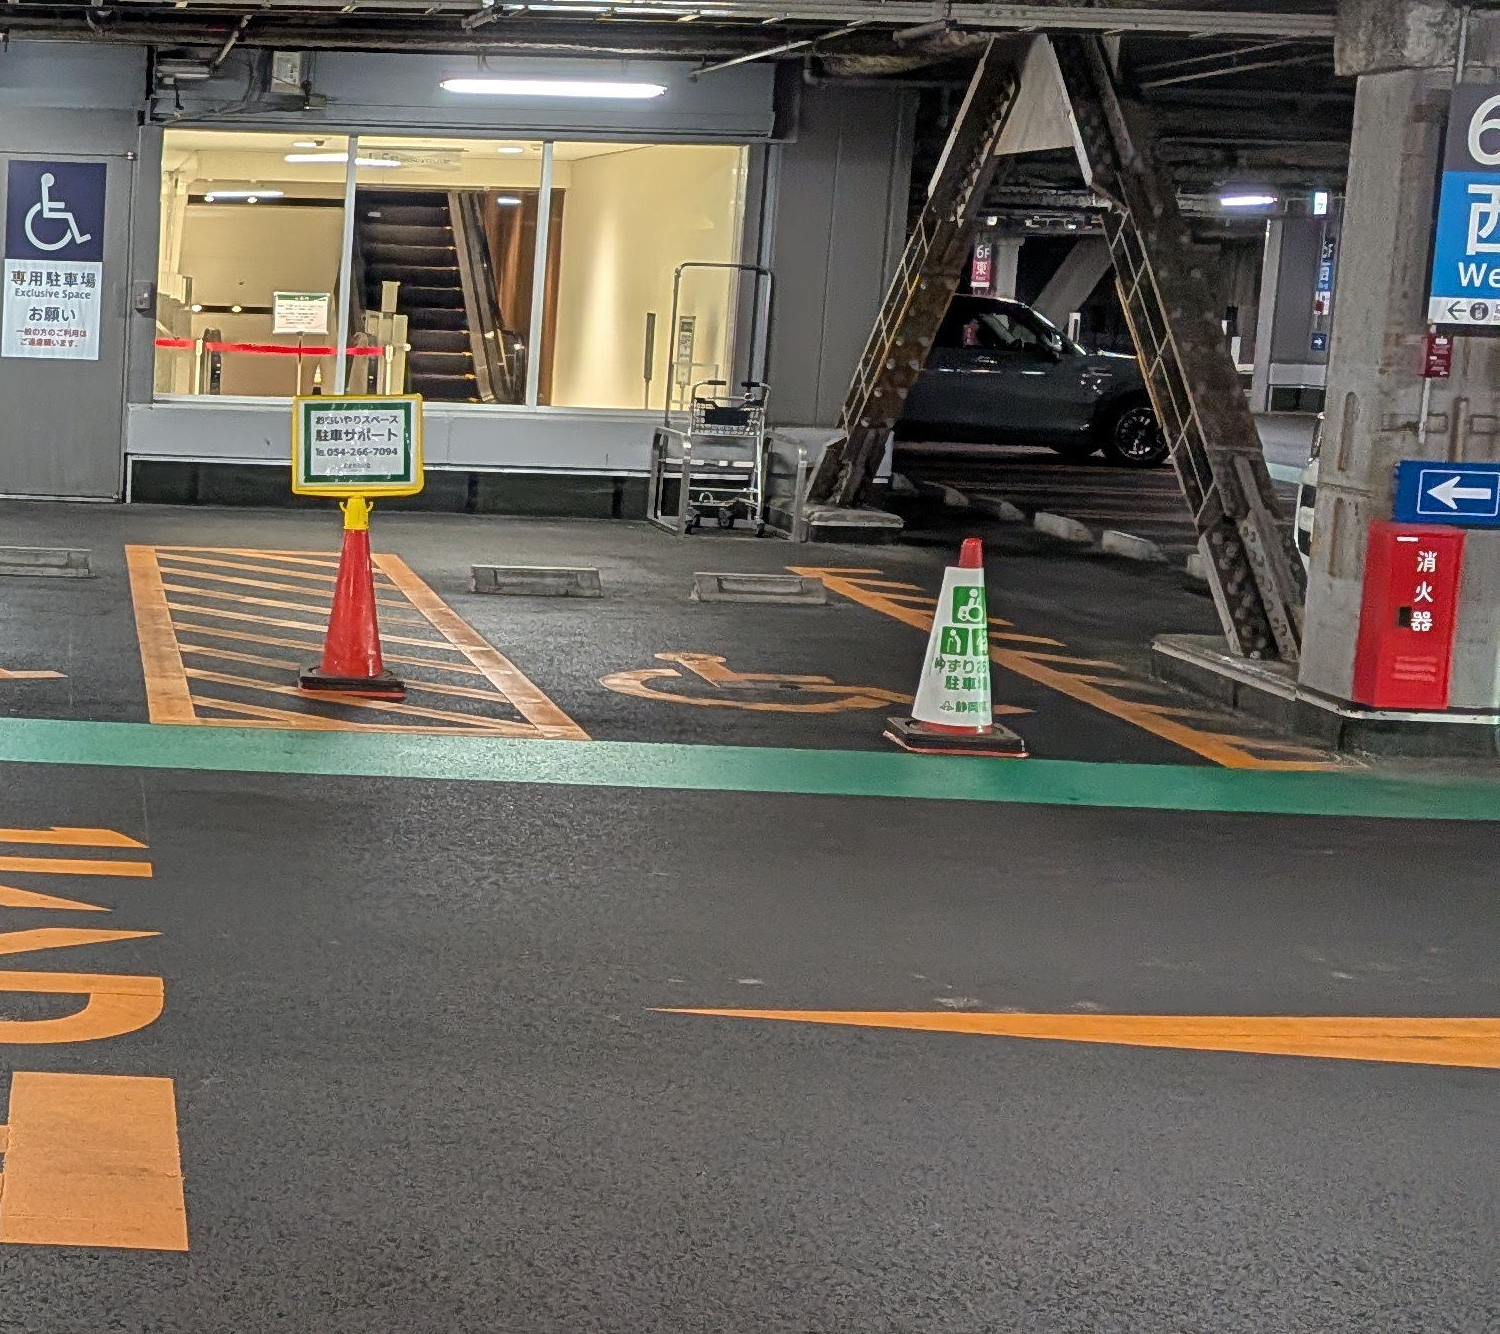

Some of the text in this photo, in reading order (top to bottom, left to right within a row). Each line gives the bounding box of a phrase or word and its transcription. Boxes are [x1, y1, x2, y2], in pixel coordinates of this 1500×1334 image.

[976, 244, 991, 259] 6F
[976, 261, 988, 275] 東
[11, 270, 97, 289] 専用駐車場
[14, 287, 91, 300] Exclusive Space
[28, 306, 76, 322] お願い
[16, 327, 88, 338] 一般の方のご利用は
[315, 428, 398, 442] 駐車サポート
[326, 447, 398, 456] 054-266-7094
[1410, 550, 1438, 633] 消火器
